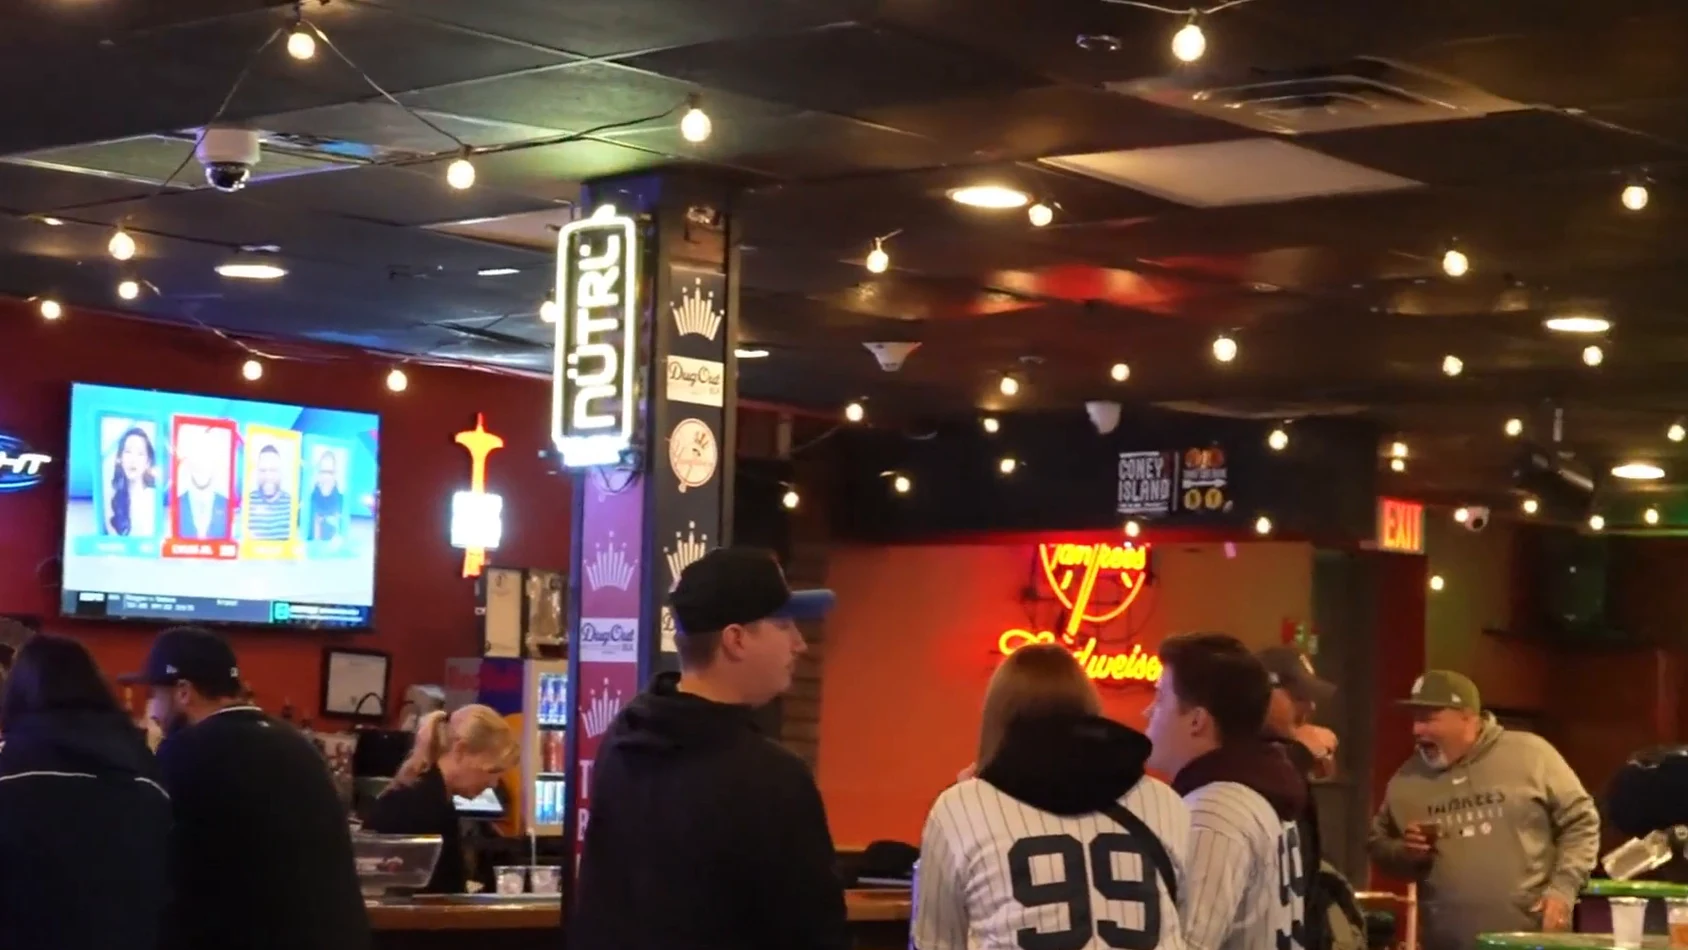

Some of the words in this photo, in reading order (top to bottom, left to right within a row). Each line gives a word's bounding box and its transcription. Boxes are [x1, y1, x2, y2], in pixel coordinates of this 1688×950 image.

[1119, 457, 1164, 480] CONEY
[1119, 479, 1170, 502] ISLAND
[1383, 500, 1422, 550] EXIT
[1008, 832, 1161, 950] 99
